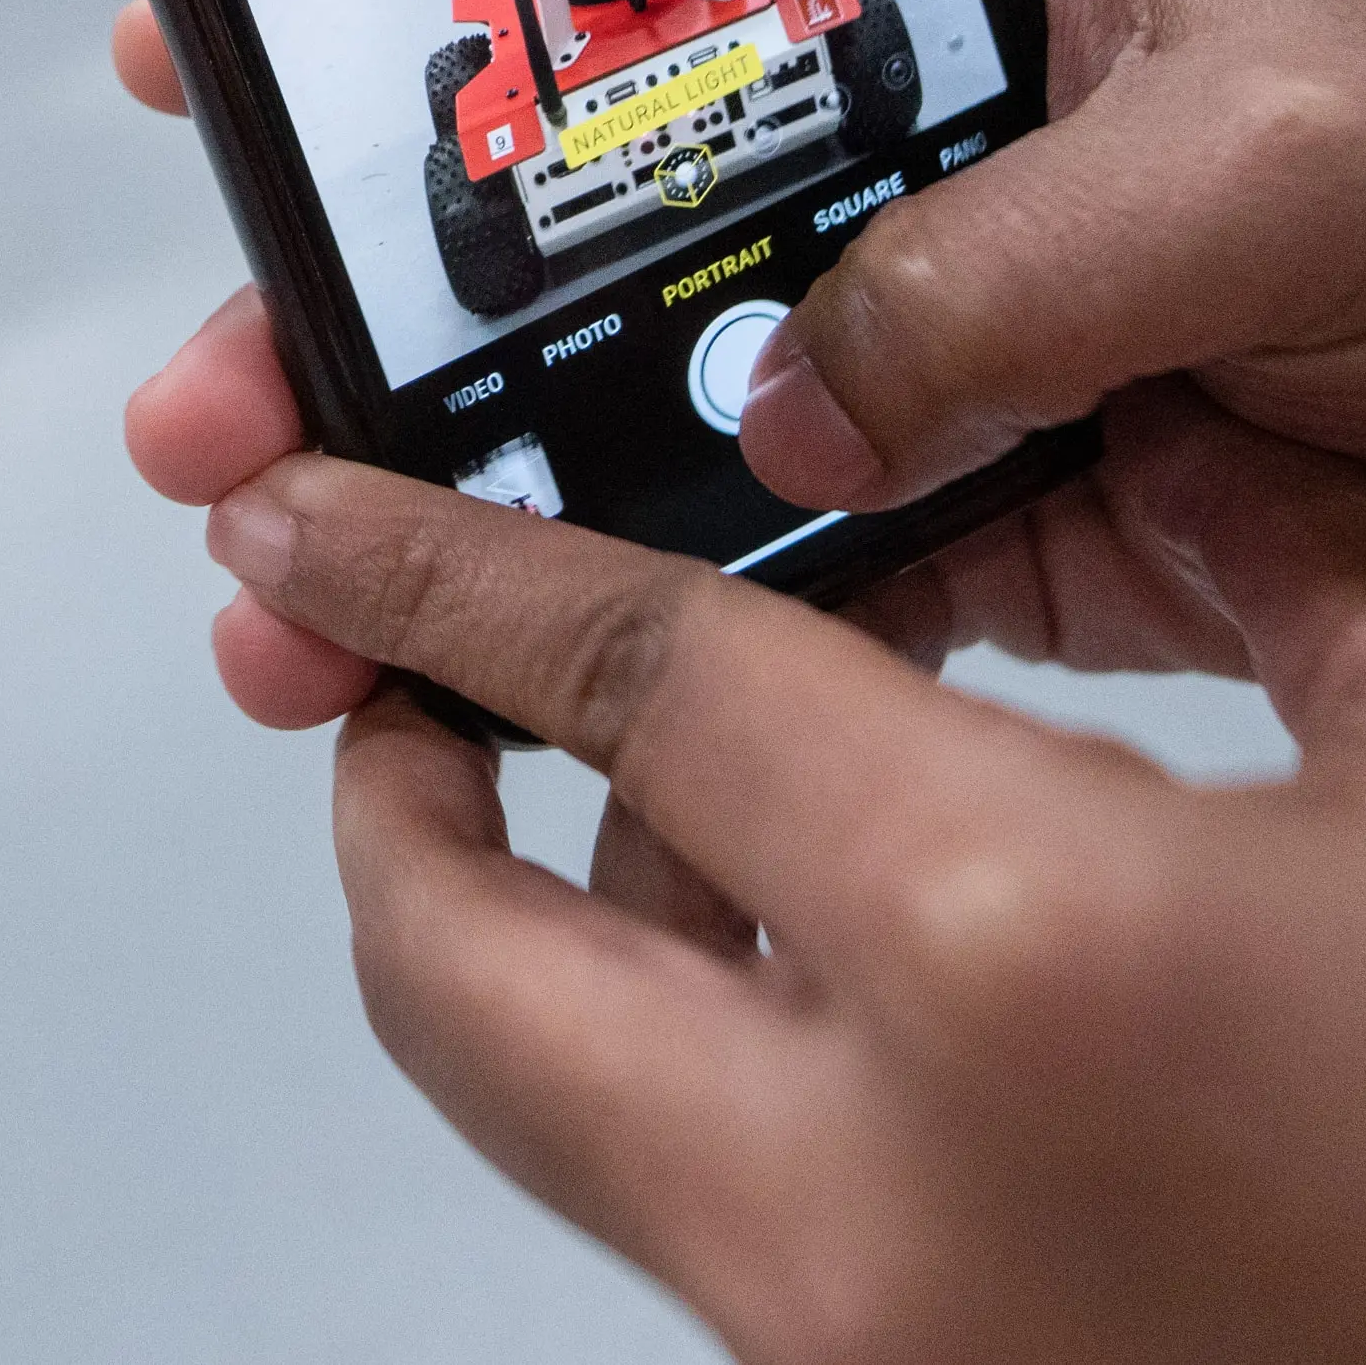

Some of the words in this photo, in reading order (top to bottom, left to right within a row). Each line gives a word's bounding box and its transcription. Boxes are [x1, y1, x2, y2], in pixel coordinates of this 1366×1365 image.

[495, 135, 506, 150] 9
[572, 91, 680, 154] NATURAL
[684, 53, 749, 102] LIGHT
[442, 371, 505, 414] VIDEO
[541, 312, 623, 367] PHOTO
[661, 235, 773, 308] PORTRAIT
[813, 170, 907, 234] SQUARE
